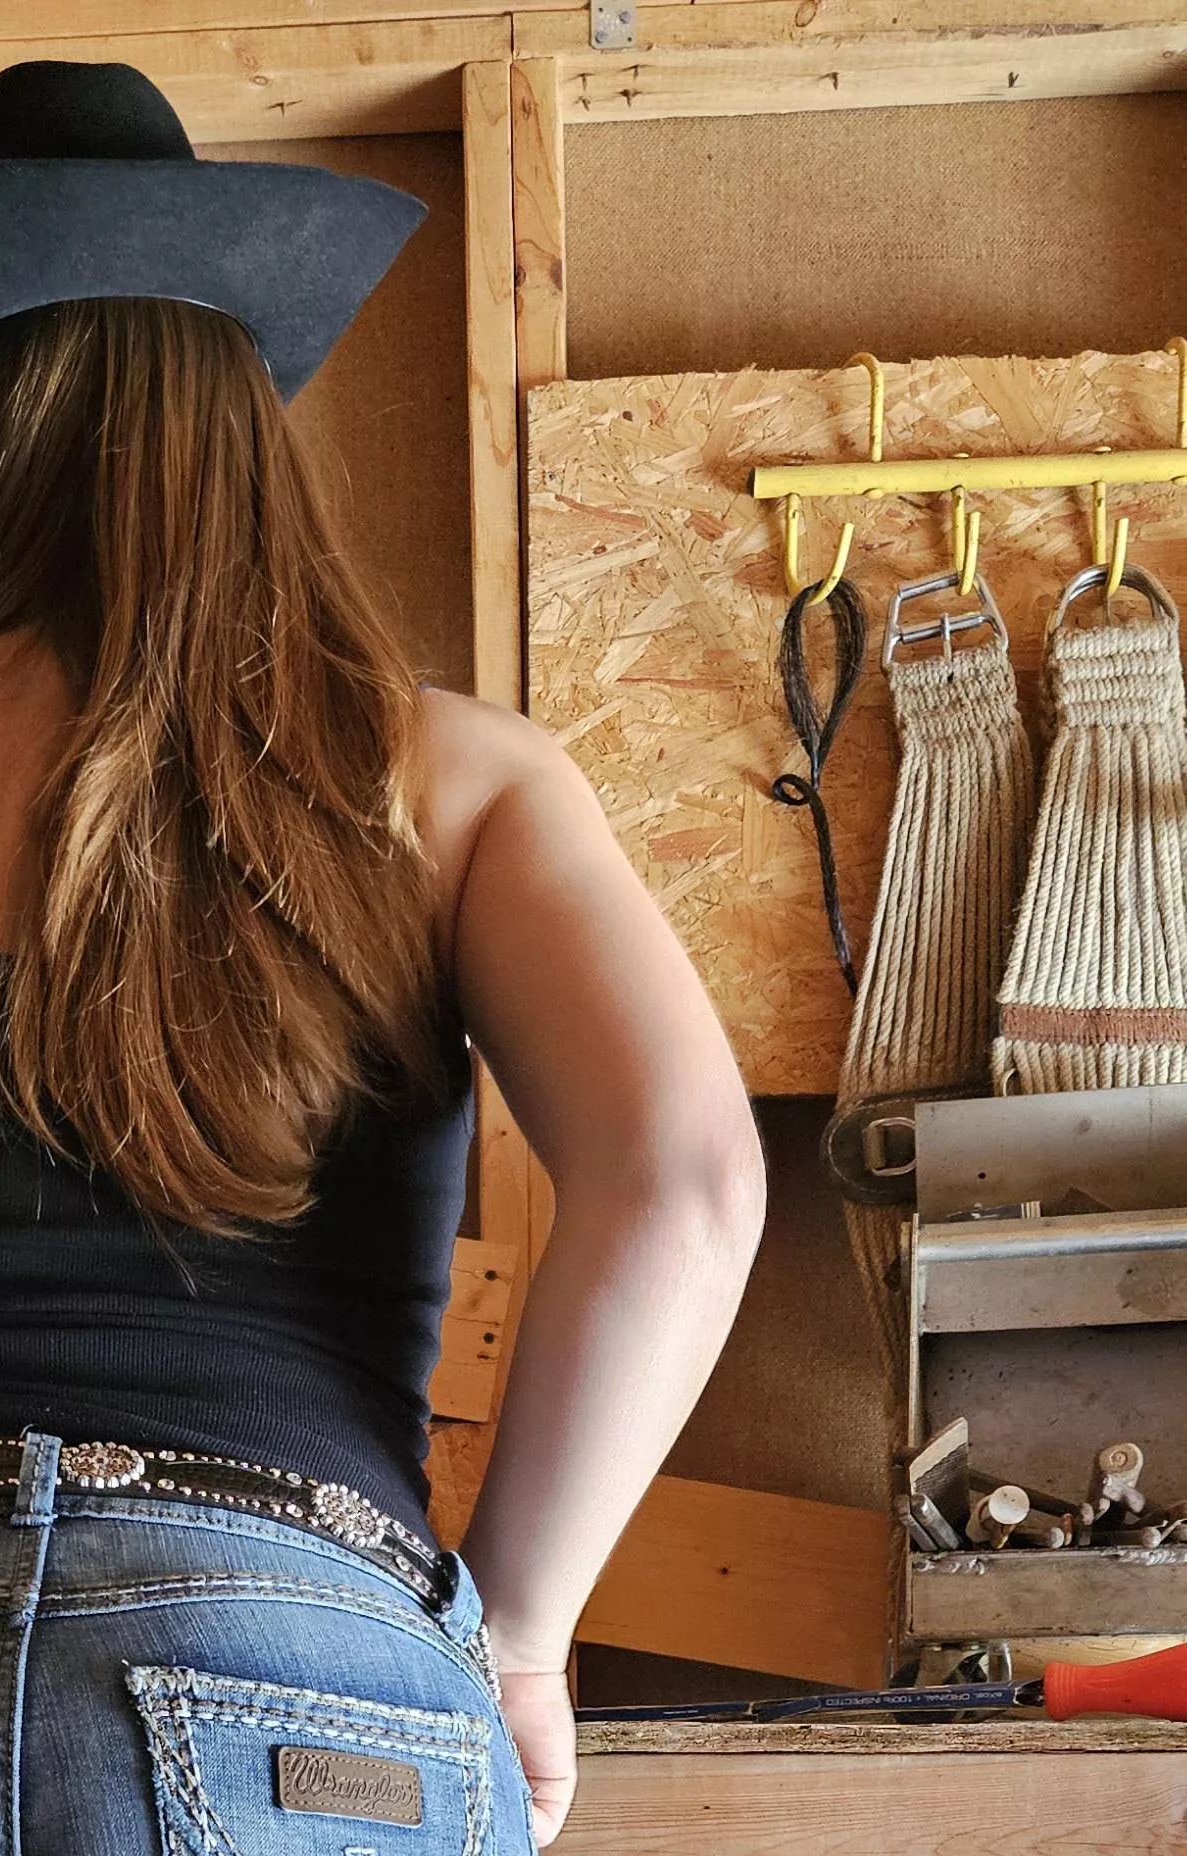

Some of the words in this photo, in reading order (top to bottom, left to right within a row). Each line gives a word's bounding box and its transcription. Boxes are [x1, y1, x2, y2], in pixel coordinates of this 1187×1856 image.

[825, 1696, 882, 1706] INSPECTED
[924, 1691, 971, 1702] ORIGINAL
[289, 1753, 414, 1815] Wrangler
